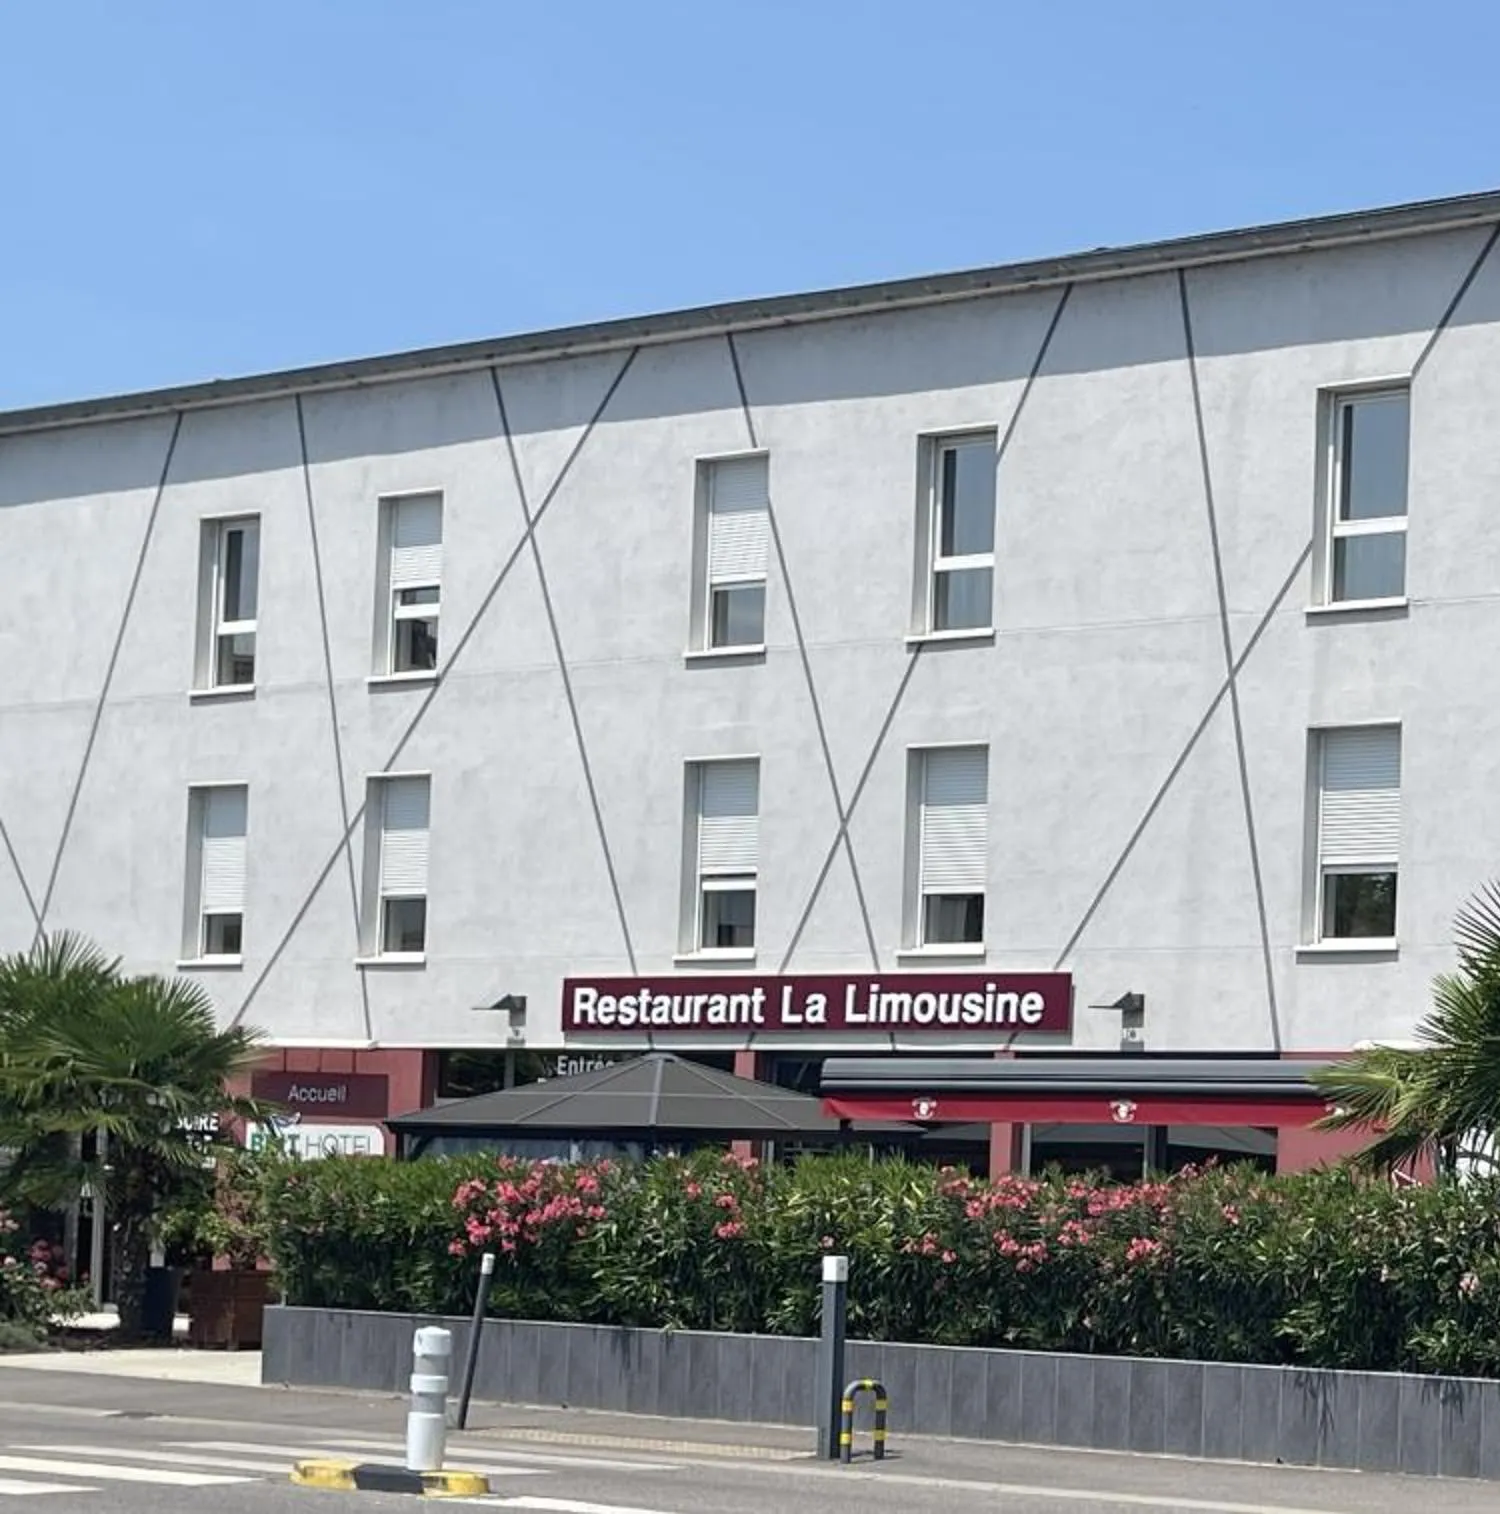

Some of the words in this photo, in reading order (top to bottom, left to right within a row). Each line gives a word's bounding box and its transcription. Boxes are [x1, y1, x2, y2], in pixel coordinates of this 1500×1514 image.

[572, 986, 766, 1026] Restaurant
[780, 985, 827, 1024] La
[844, 983, 1046, 1024] Limousine
[288, 1084, 346, 1102] Accueil
